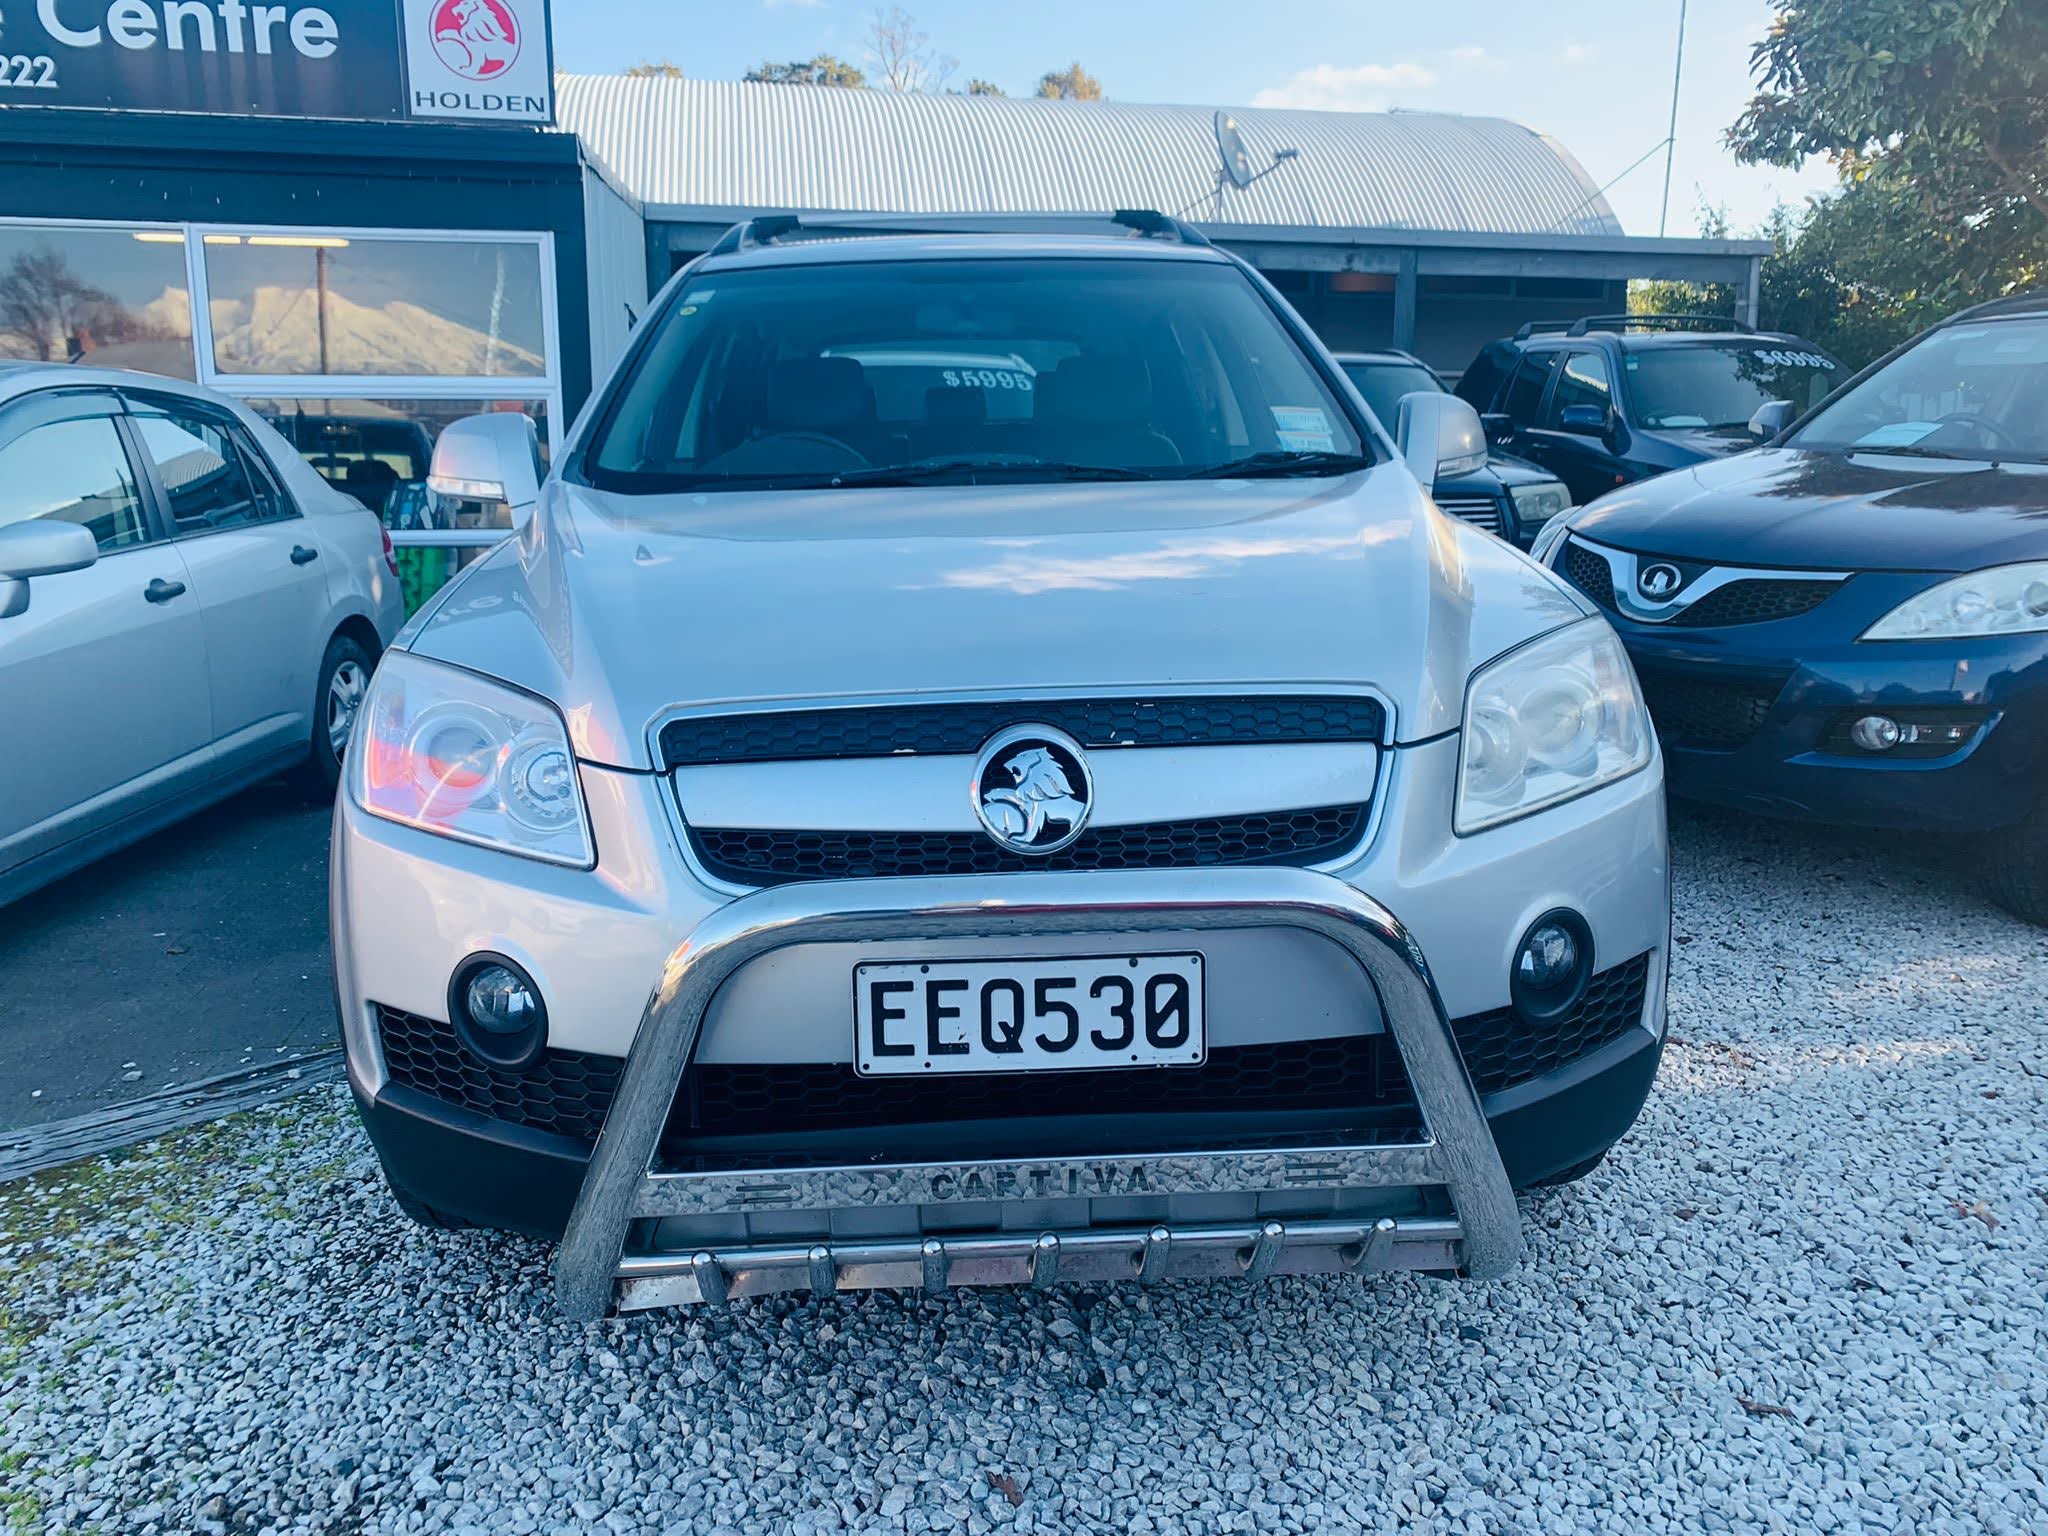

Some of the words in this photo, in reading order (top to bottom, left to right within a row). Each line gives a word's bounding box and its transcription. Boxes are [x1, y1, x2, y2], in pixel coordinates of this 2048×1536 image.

[37, 0, 339, 59] Centre
[415, 91, 545, 113] HOLDEN
[942, 370, 1033, 391] $5995
[870, 973, 1190, 1056] EEQ530
[931, 1166, 1151, 1200] CAPTIVA
